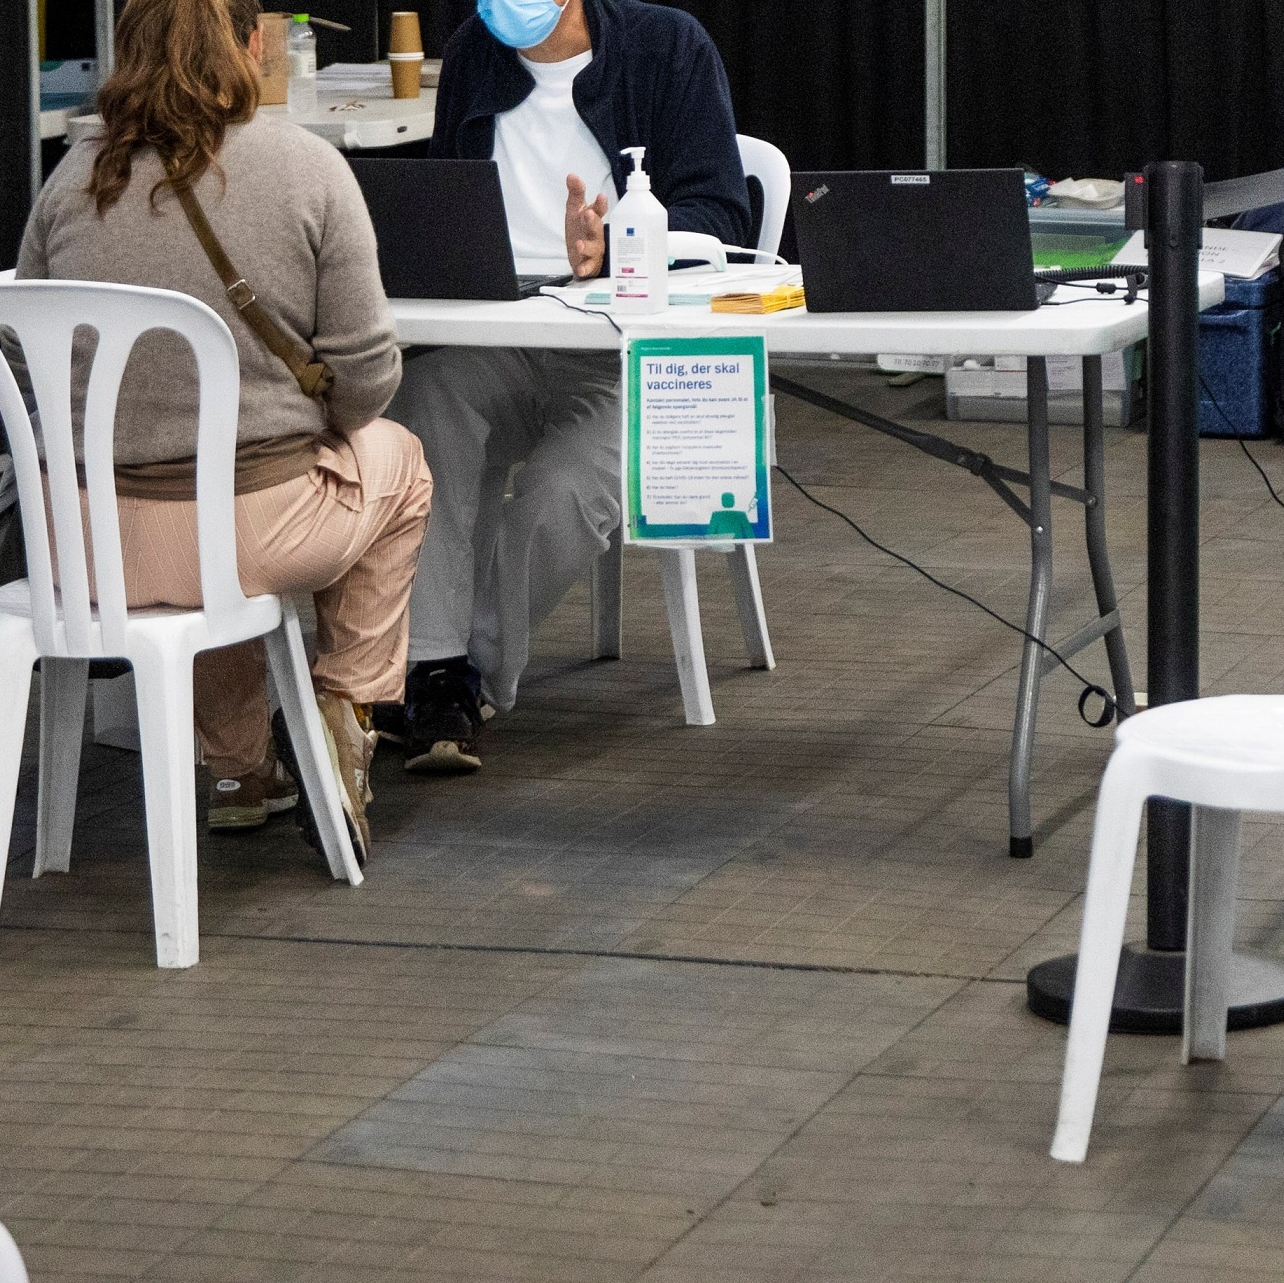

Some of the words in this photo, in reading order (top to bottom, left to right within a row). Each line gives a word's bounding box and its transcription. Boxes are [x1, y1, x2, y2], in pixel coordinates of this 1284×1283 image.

[647, 364, 661, 374] Til
[666, 364, 687, 376] dig,
[691, 364, 711, 374] der
[715, 363, 739, 373] skal
[647, 379, 712, 390] vaccineres
